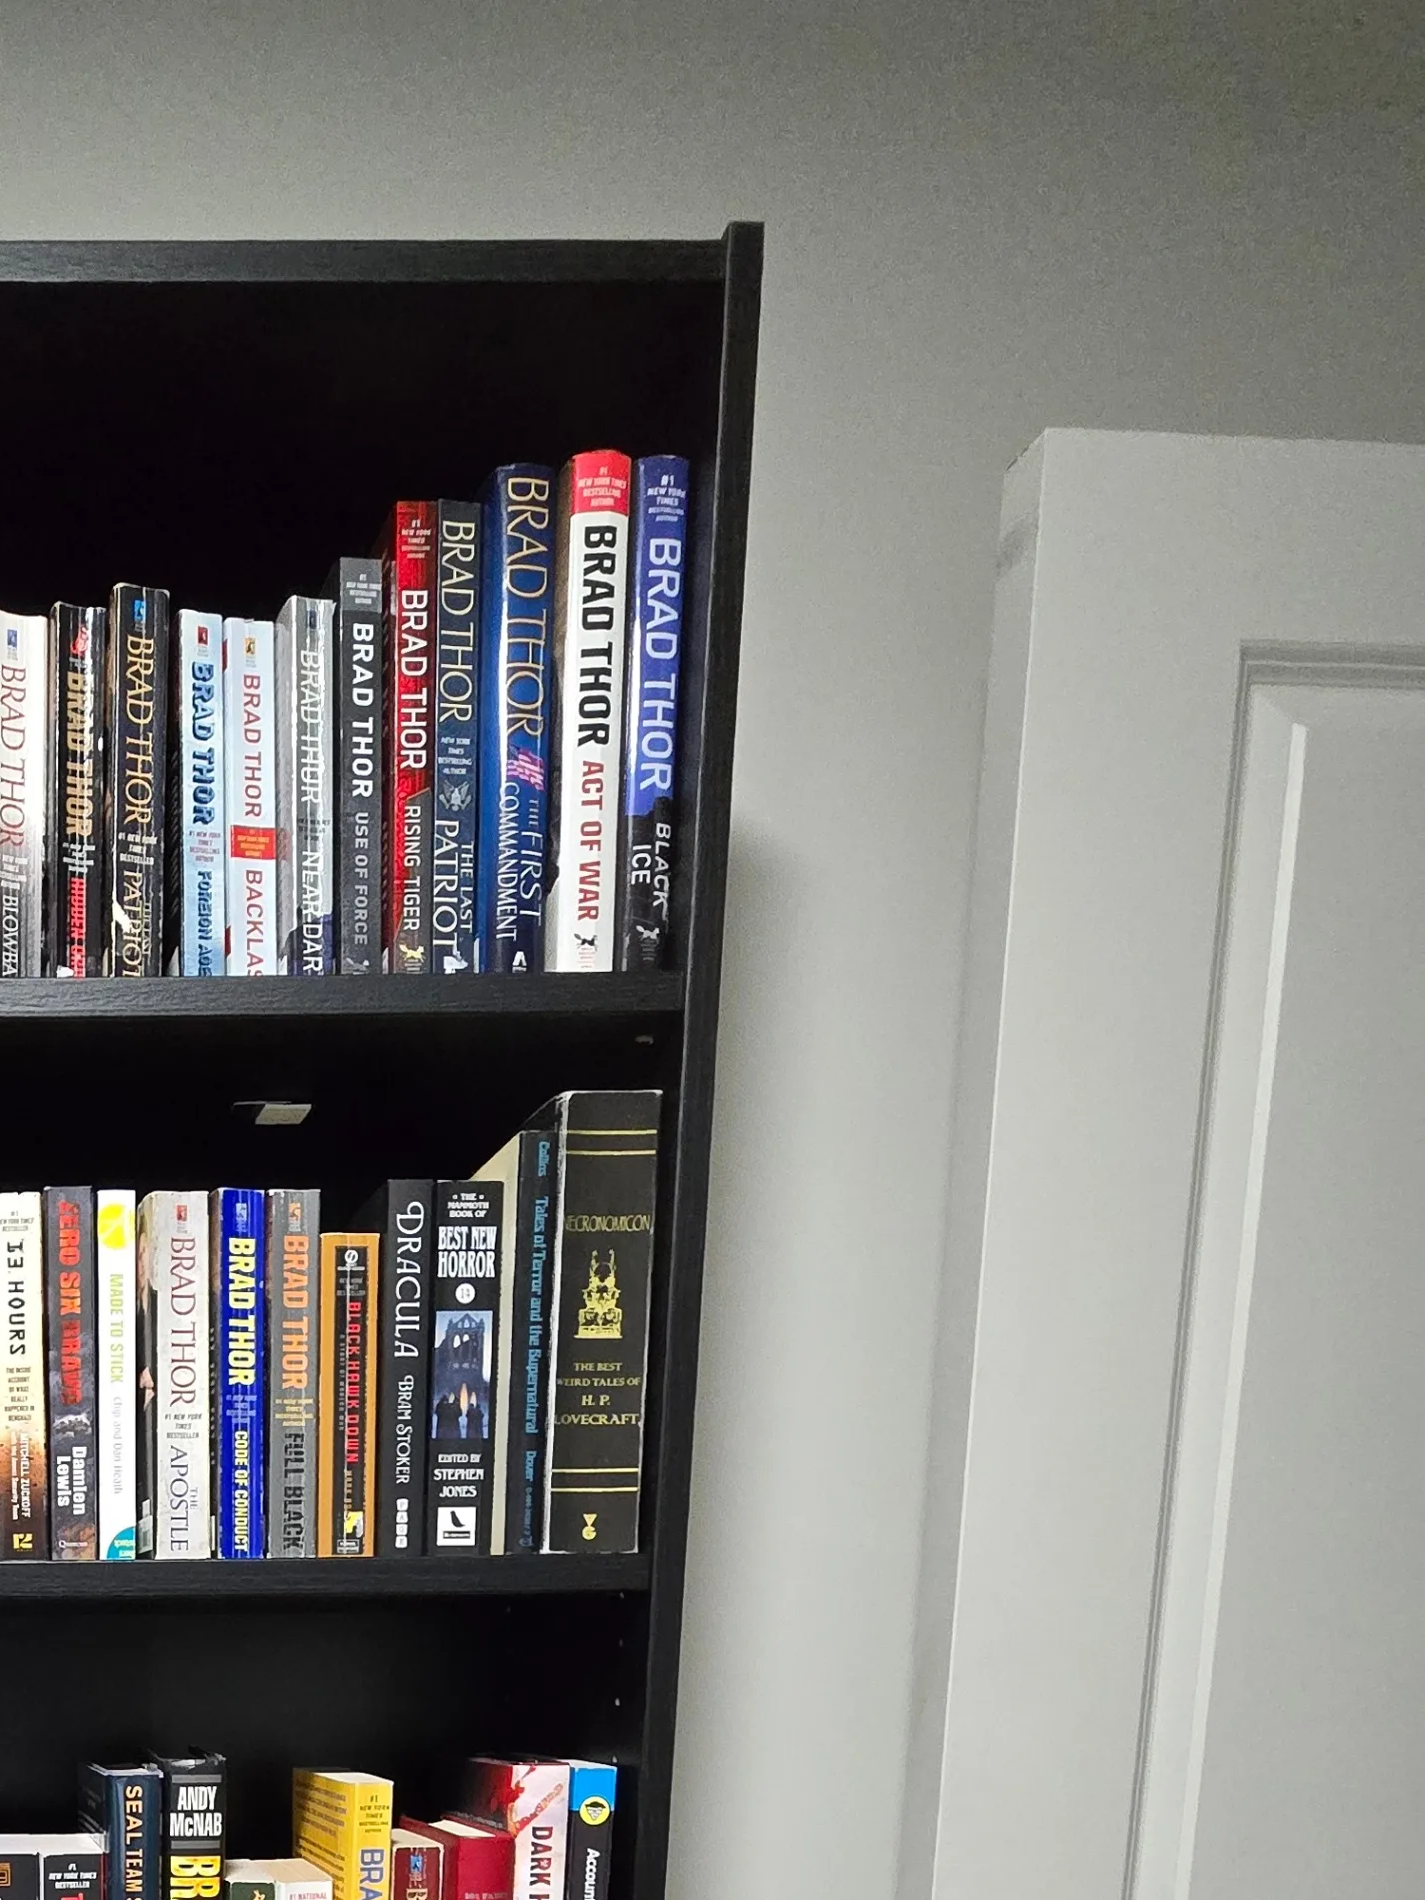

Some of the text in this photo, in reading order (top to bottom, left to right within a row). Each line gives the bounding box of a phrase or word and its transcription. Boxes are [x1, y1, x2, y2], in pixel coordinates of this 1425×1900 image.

[439, 520, 474, 722] BRAD THOR
[507, 477, 548, 736] BRAD THOR
[641, 538, 681, 791] BRAD THOR
[0, 664, 26, 751] BRAD
[125, 634, 154, 825] BRAD THOR
[576, 525, 617, 921] BRAD THOR ACT OF WAR
[352, 622, 374, 945] BRAD THOR USE OF FORCE
[401, 590, 428, 932] BRAD THOR RISING TIGER
[0, 763, 25, 847] THOR
[632, 845, 652, 885] ICE
[653, 824, 671, 907] BLACK
[438, 1251, 495, 1278] HORROR
[171, 1238, 196, 1407] BRAD THOR
[229, 1238, 255, 1551] BRAD THOR CODE OF CONDUCT
[170, 1446, 190, 1551] APOSTLE
[433, 1468, 484, 1480] STEPHEN
[438, 1453, 481, 1463] EDITED BY
[439, 1485, 477, 1497] JONES
[125, 1785, 142, 1844] SEAL
[170, 1812, 221, 1836] McNAB
[178, 1786, 216, 1809] ANDY
[125, 1848, 142, 1893] TEAM
[530, 1826, 553, 1890] DARK
